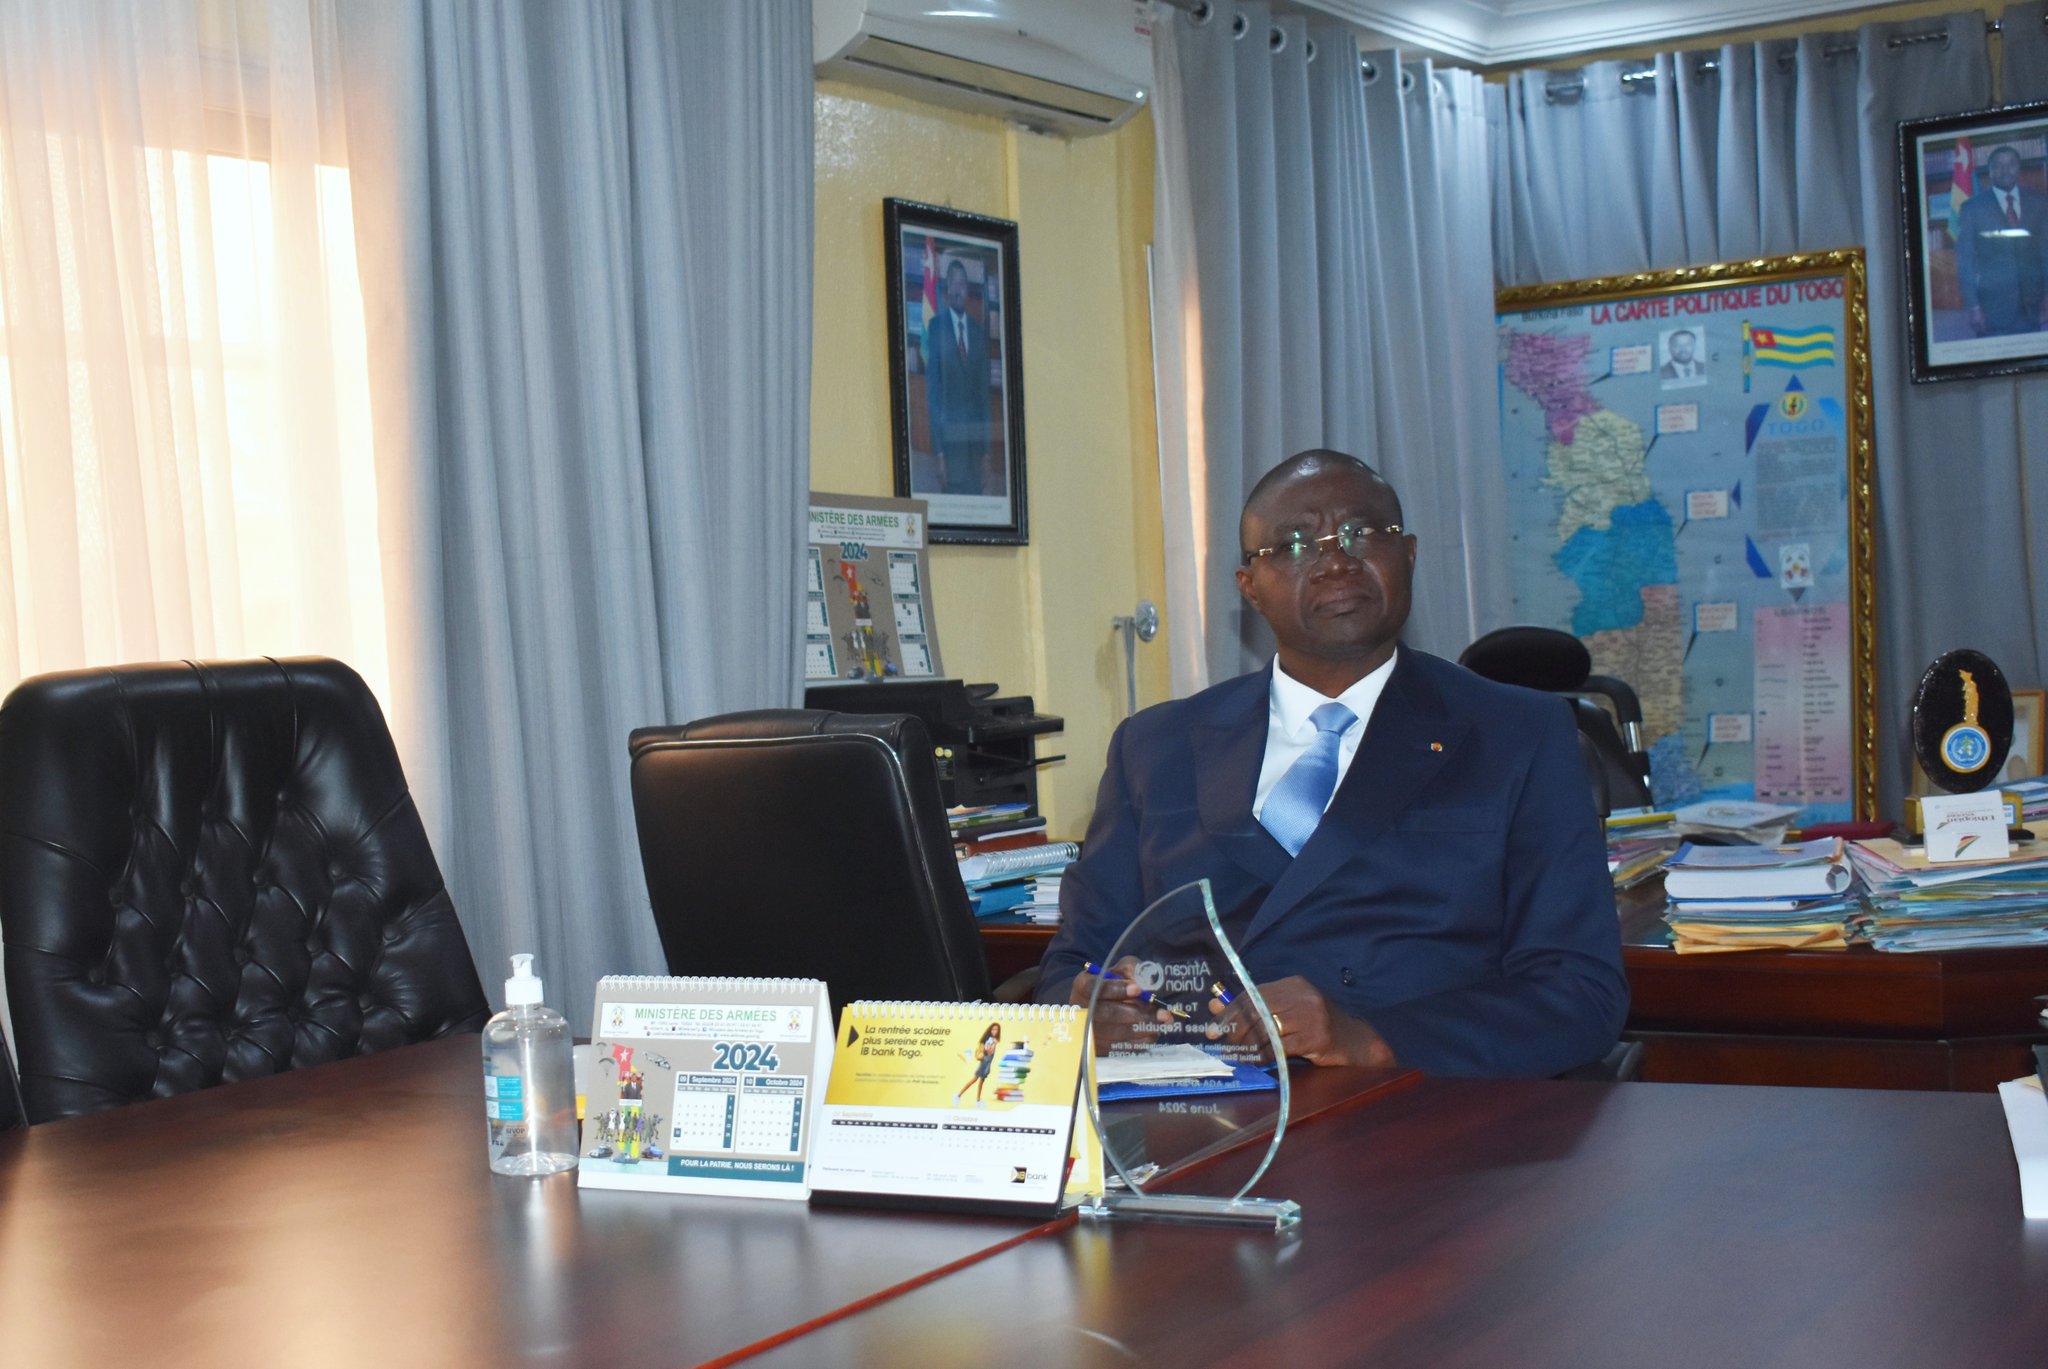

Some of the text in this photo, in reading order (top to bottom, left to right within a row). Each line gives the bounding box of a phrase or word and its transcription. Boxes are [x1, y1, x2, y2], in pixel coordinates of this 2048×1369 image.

[1591, 279, 1844, 325] LA CARTE POLITIQUE DU TOGO
[808, 509, 845, 524] INISTÈRE
[847, 513, 864, 526] DES
[840, 542, 869, 560] 2024
[634, 1006, 777, 1022] MINISTÈRE DES ARMÉES
[865, 1025, 951, 1036] La rentrée scolaire
[862, 1036, 944, 1047] plus sereine avec
[713, 1043, 778, 1071] 2024
[871, 1047, 895, 1056] bank
[898, 1047, 923, 1060] Togo.
[681, 1159, 699, 1167] POUR
[734, 1162, 752, 1170] NOUS
[754, 1163, 780, 1171] SERONS
[1027, 1172, 1048, 1181] bank
